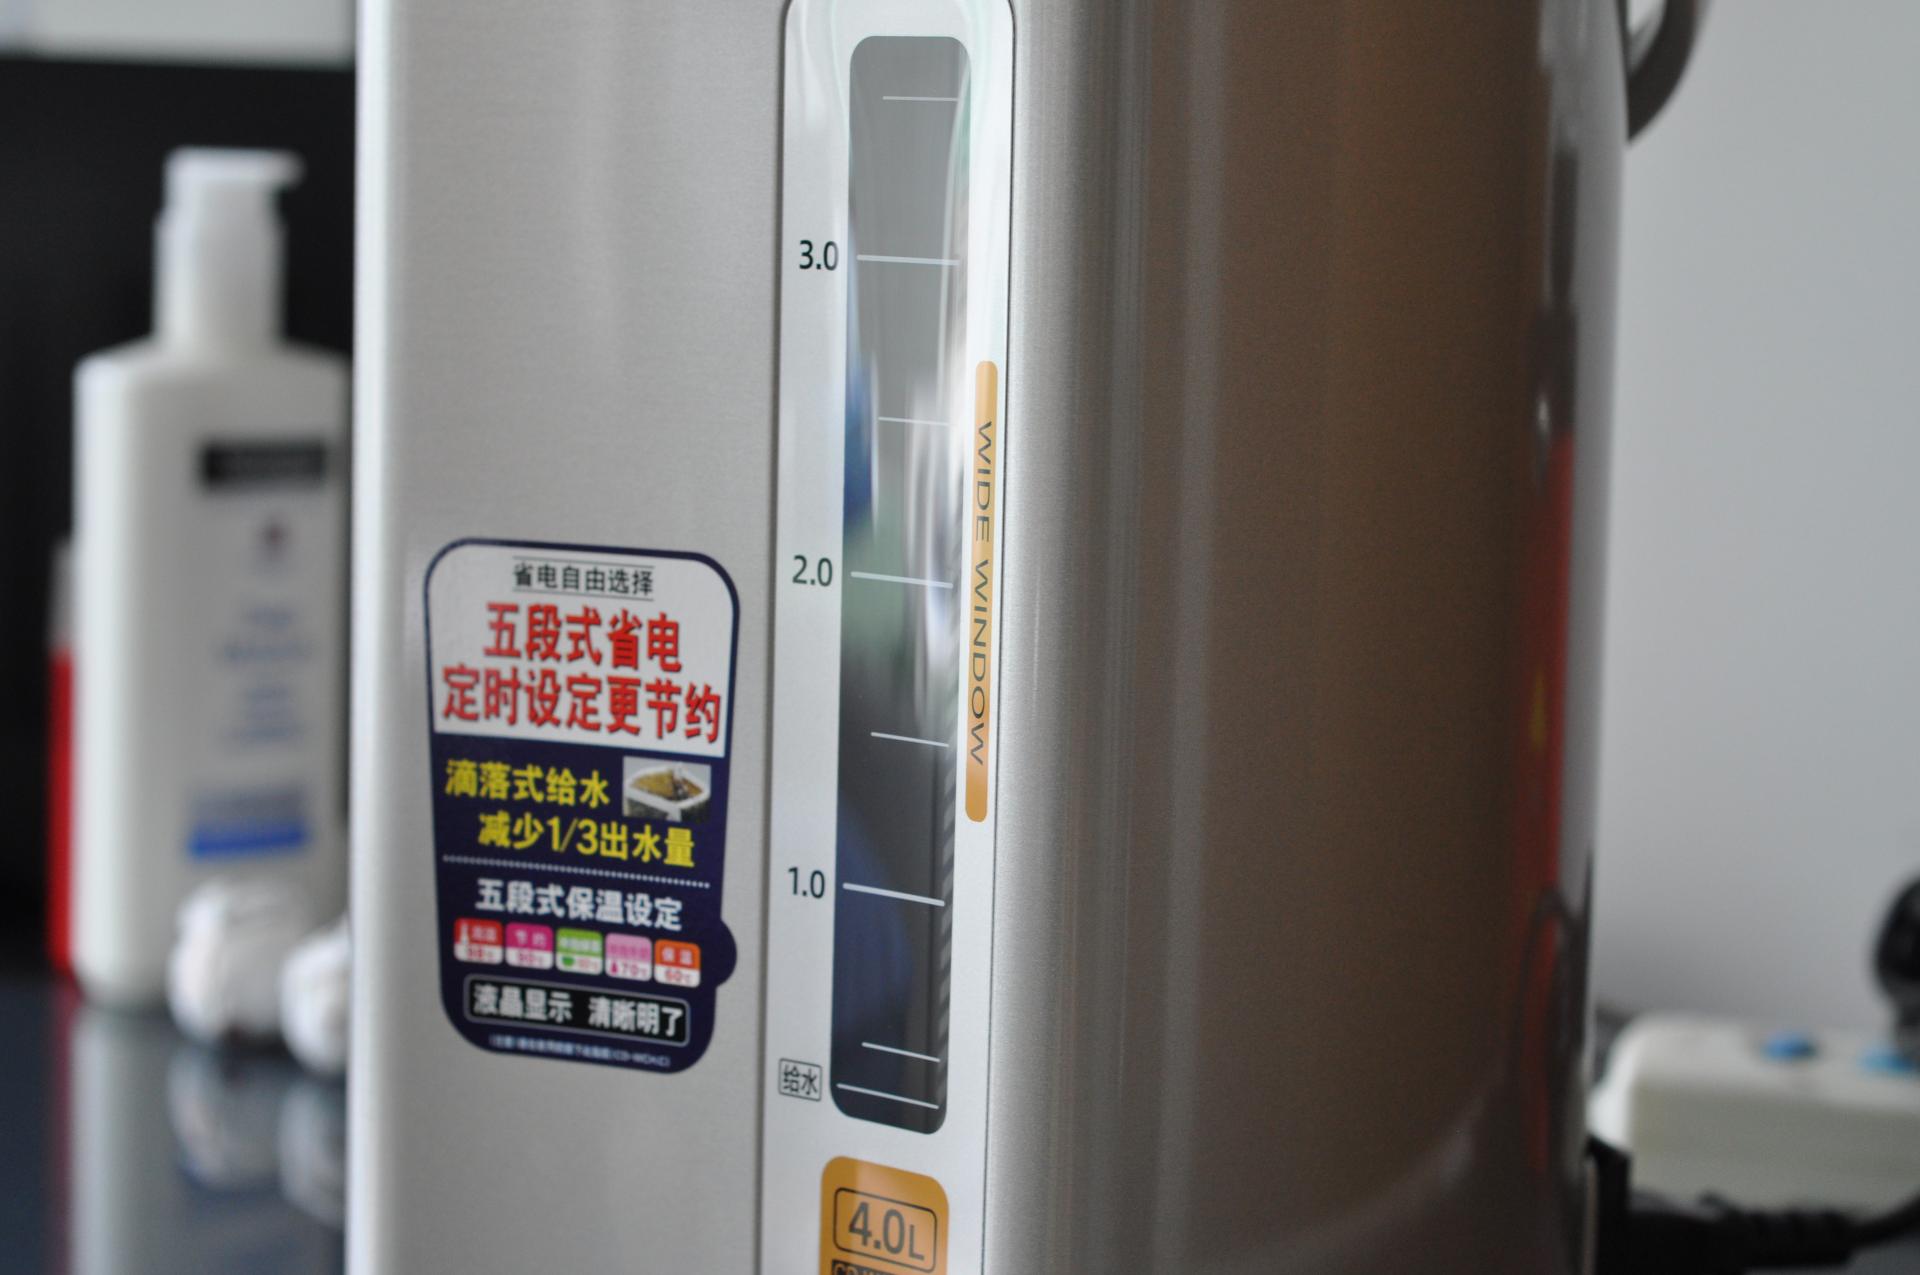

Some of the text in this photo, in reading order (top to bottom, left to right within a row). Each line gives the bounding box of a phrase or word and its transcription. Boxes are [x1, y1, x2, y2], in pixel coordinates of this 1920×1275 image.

[799, 239, 839, 271] 3.0
[513, 561, 654, 597] 省电自由选择
[792, 554, 833, 587] 2.0
[969, 420, 994, 767] WIDE WINDOW
[482, 601, 684, 673] 五段式省电
[441, 663, 722, 744] 定时设定更节约
[444, 758, 611, 808] 滴落式给水
[478, 811, 696, 868] 减少1/3出水量
[474, 877, 683, 932] 五段式保温设定
[787, 866, 825, 899] 1.0
[473, 984, 685, 1037] 液晶显示 清晰明了
[783, 1064, 818, 1095] 给水
[848, 1201, 926, 1261] 4.0L
